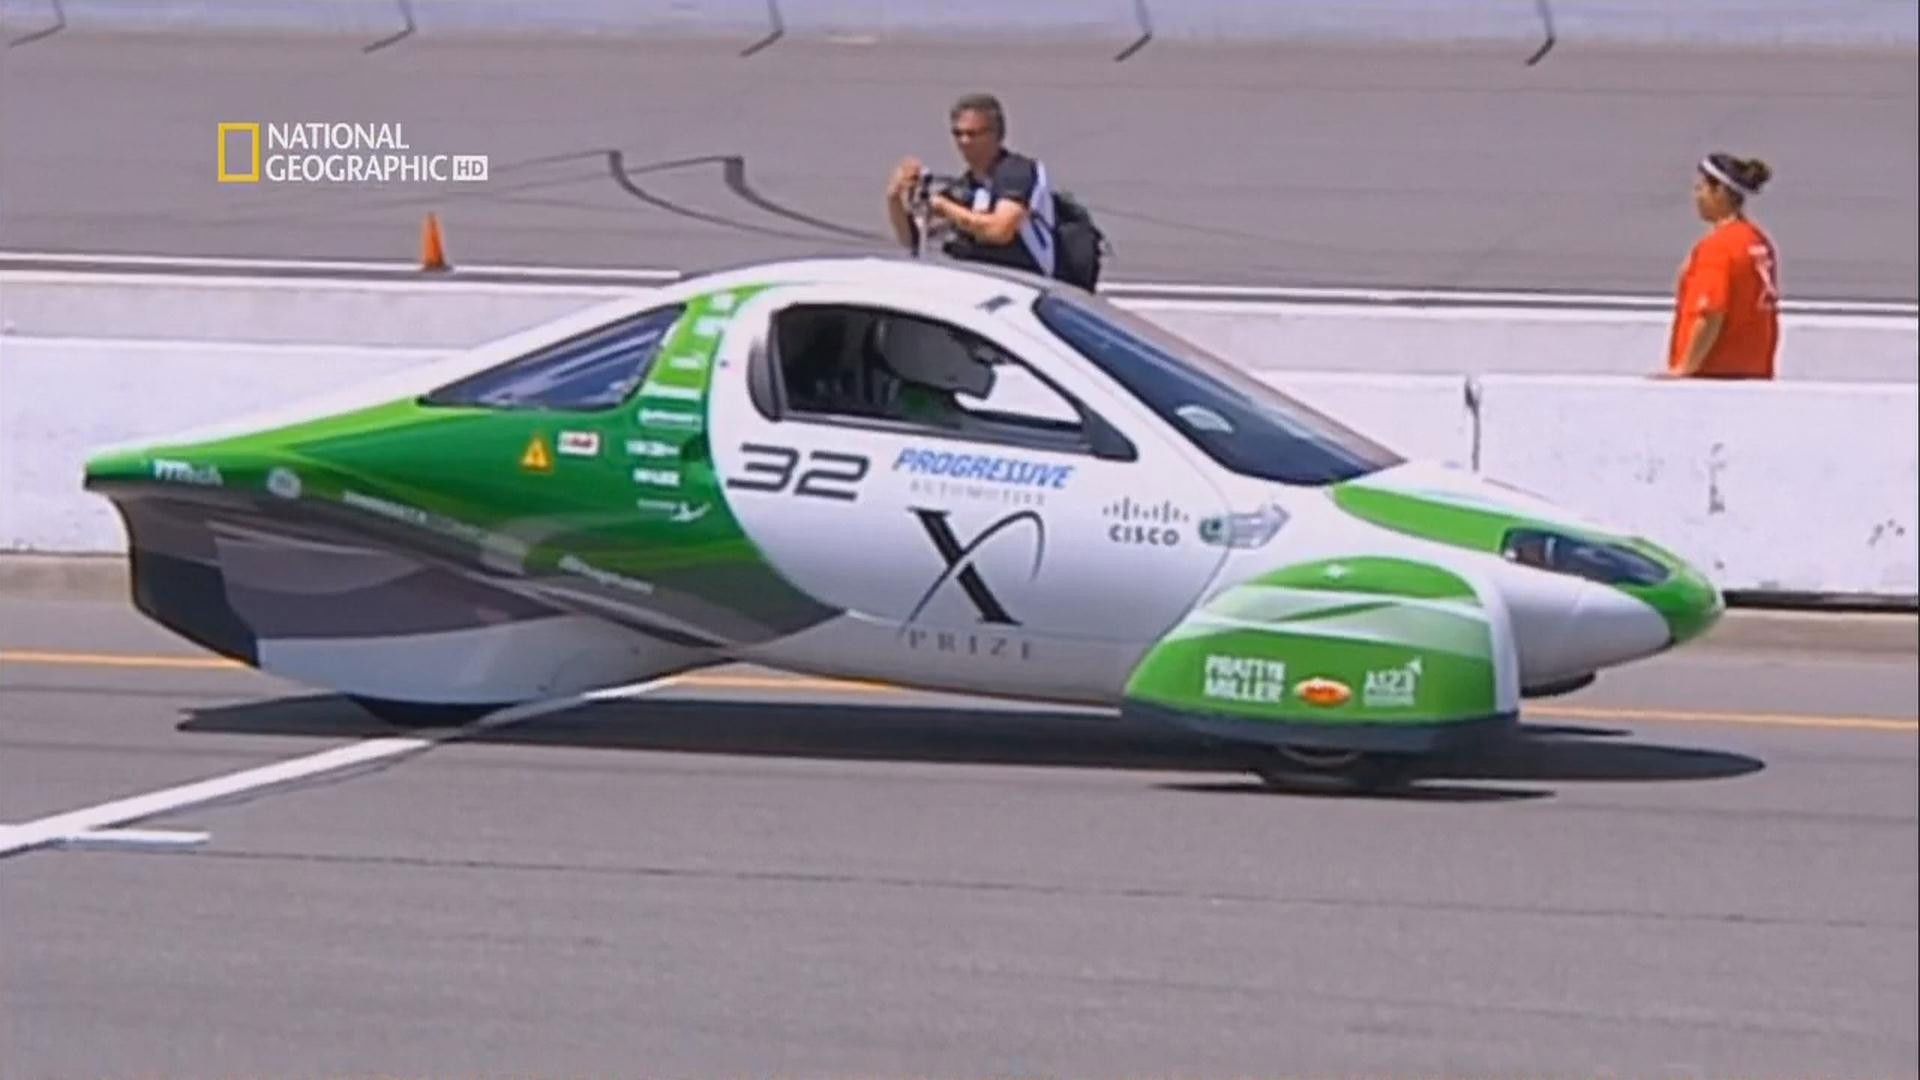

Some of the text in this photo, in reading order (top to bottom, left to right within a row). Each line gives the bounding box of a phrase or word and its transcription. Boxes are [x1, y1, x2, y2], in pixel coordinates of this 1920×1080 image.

[726, 443, 870, 501] 32
[892, 449, 1075, 489] PROGRESSIVE
[1109, 524, 1180, 546] CISCO
[909, 629, 1036, 661] PRIZE
